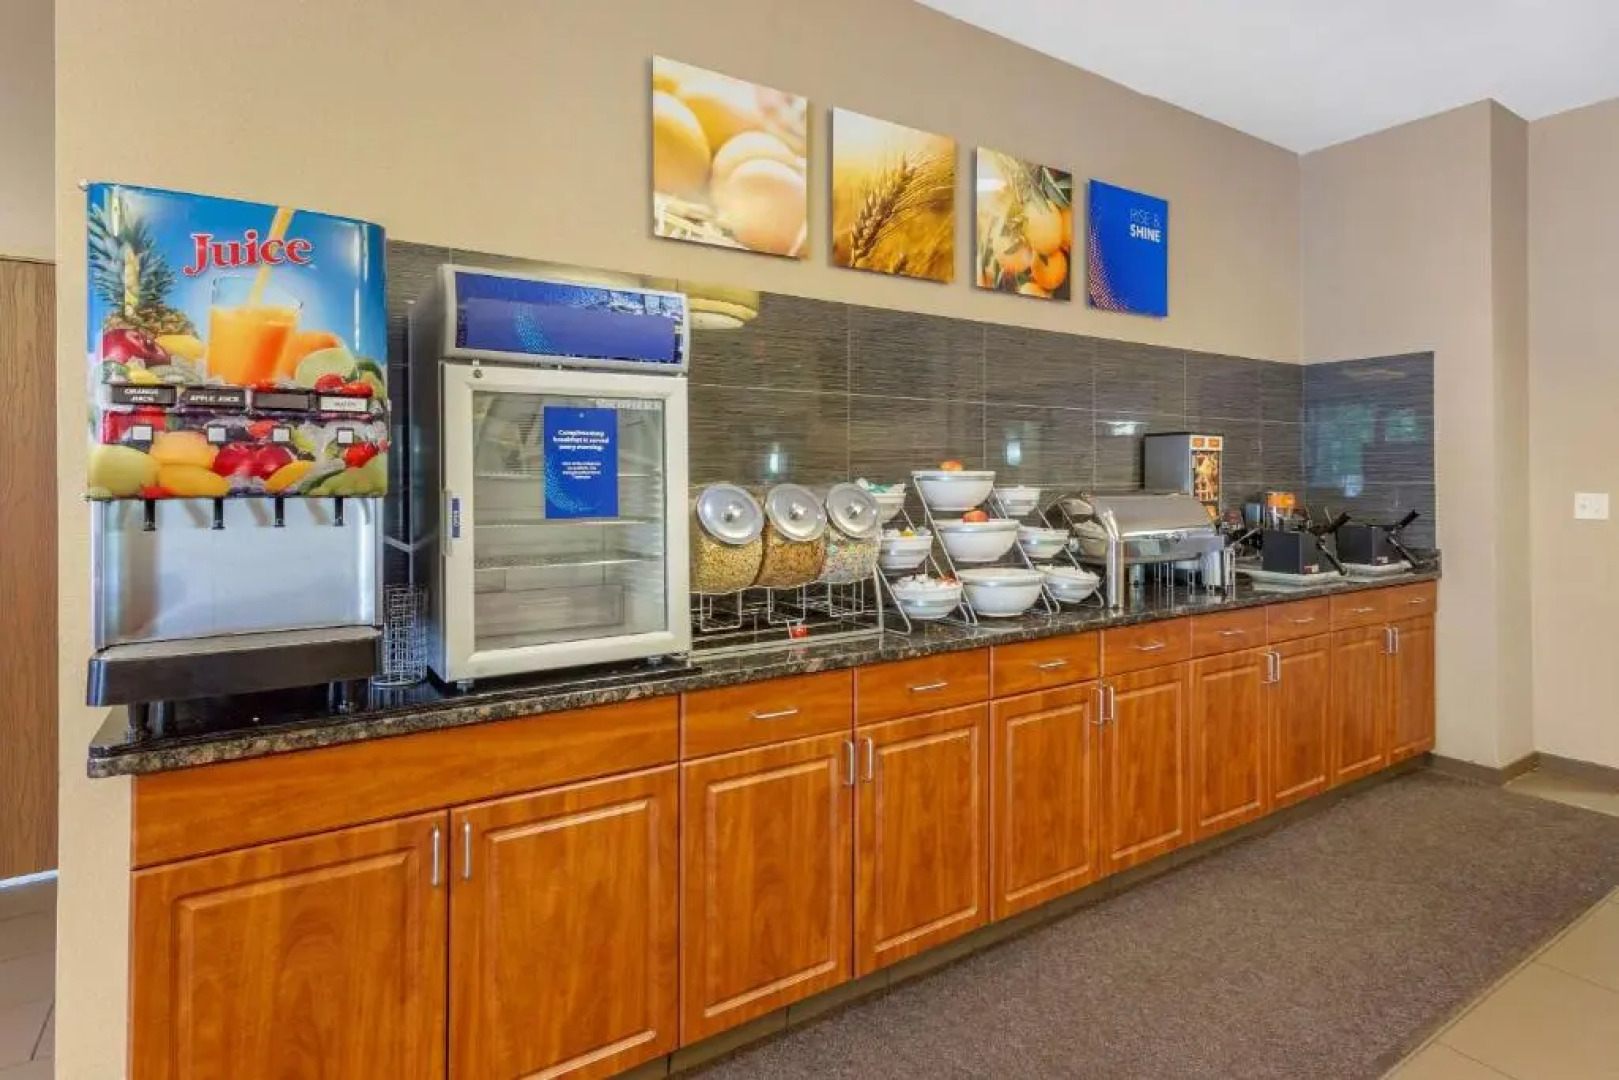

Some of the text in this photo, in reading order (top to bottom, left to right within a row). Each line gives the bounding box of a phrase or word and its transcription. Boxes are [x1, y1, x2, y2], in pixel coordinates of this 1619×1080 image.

[1130, 208, 1150, 226] RISE
[1129, 223, 1161, 243] SHINE
[183, 229, 312, 276] Juice
[189, 394, 217, 402] APPLE
[558, 429, 605, 437] Complimentary
